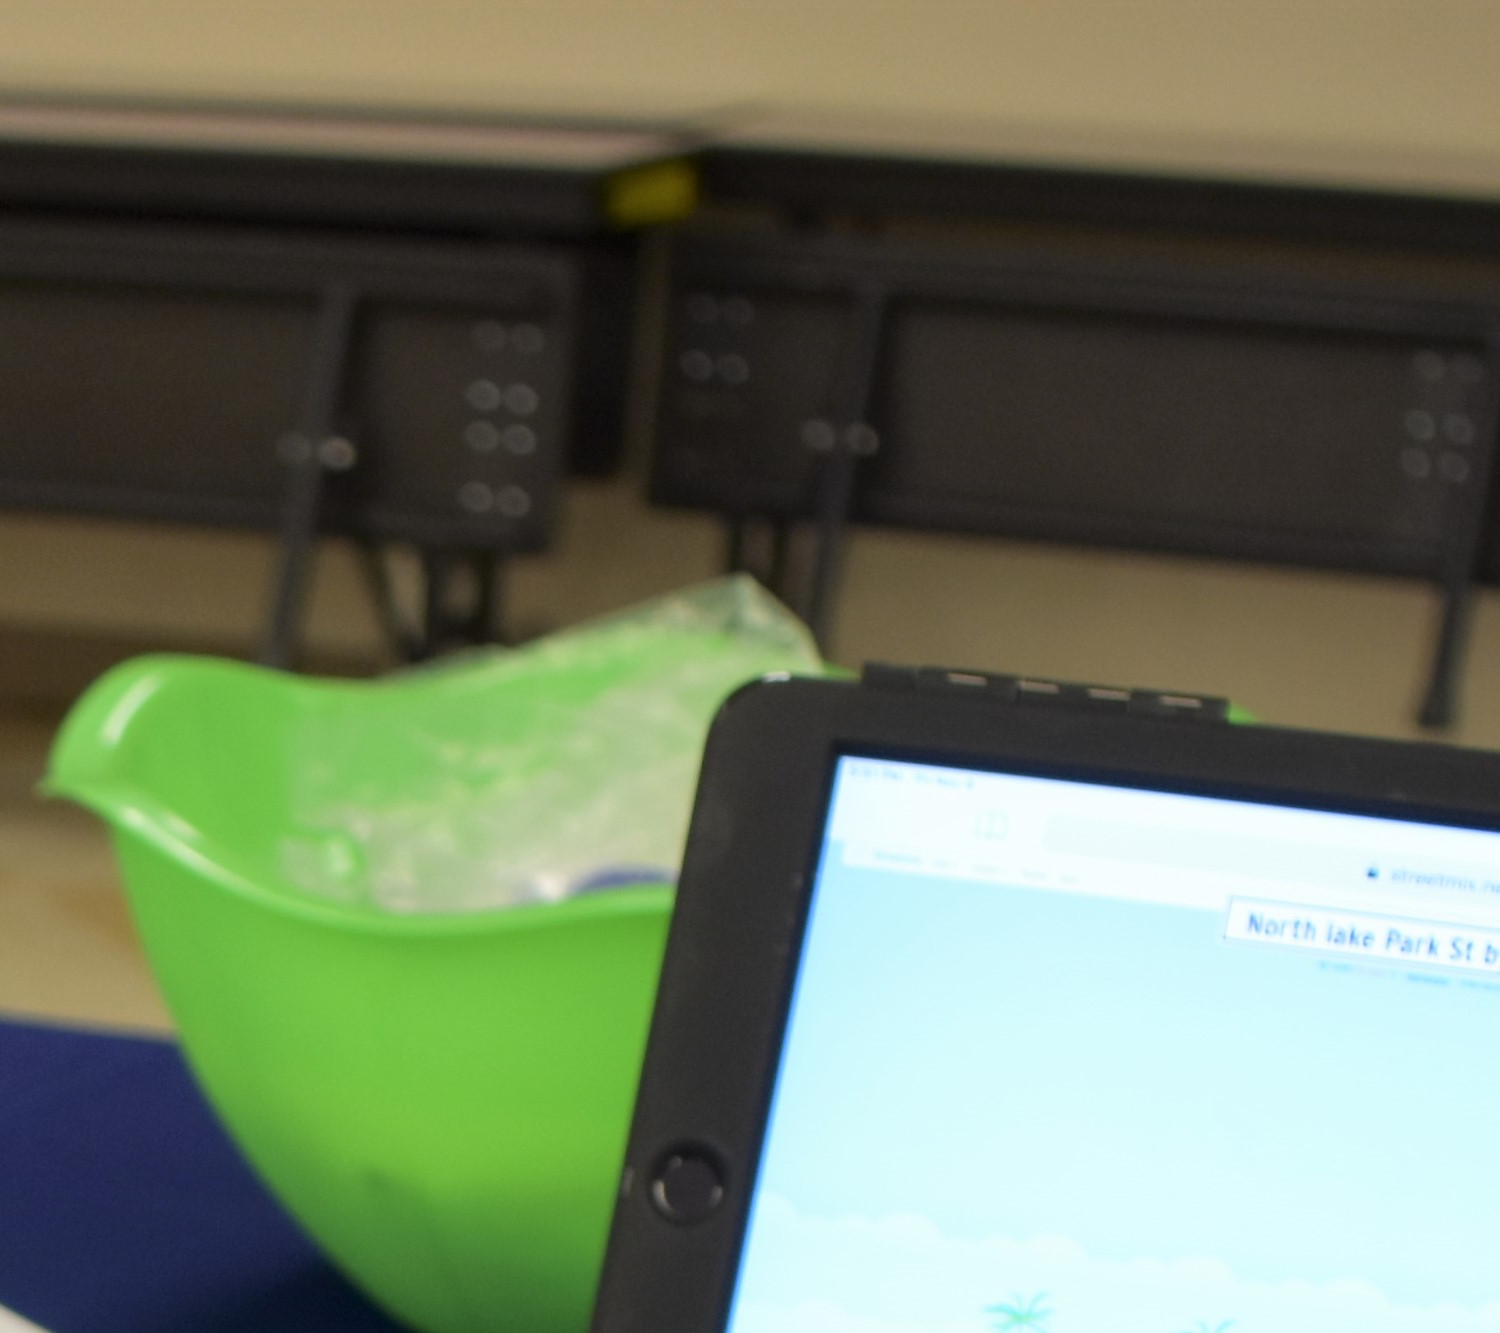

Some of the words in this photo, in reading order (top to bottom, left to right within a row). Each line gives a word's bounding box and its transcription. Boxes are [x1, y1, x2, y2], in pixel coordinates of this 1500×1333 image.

[1246, 912, 1317, 943] North
[1385, 928, 1440, 959] Park
[1449, 937, 1475, 963] St
